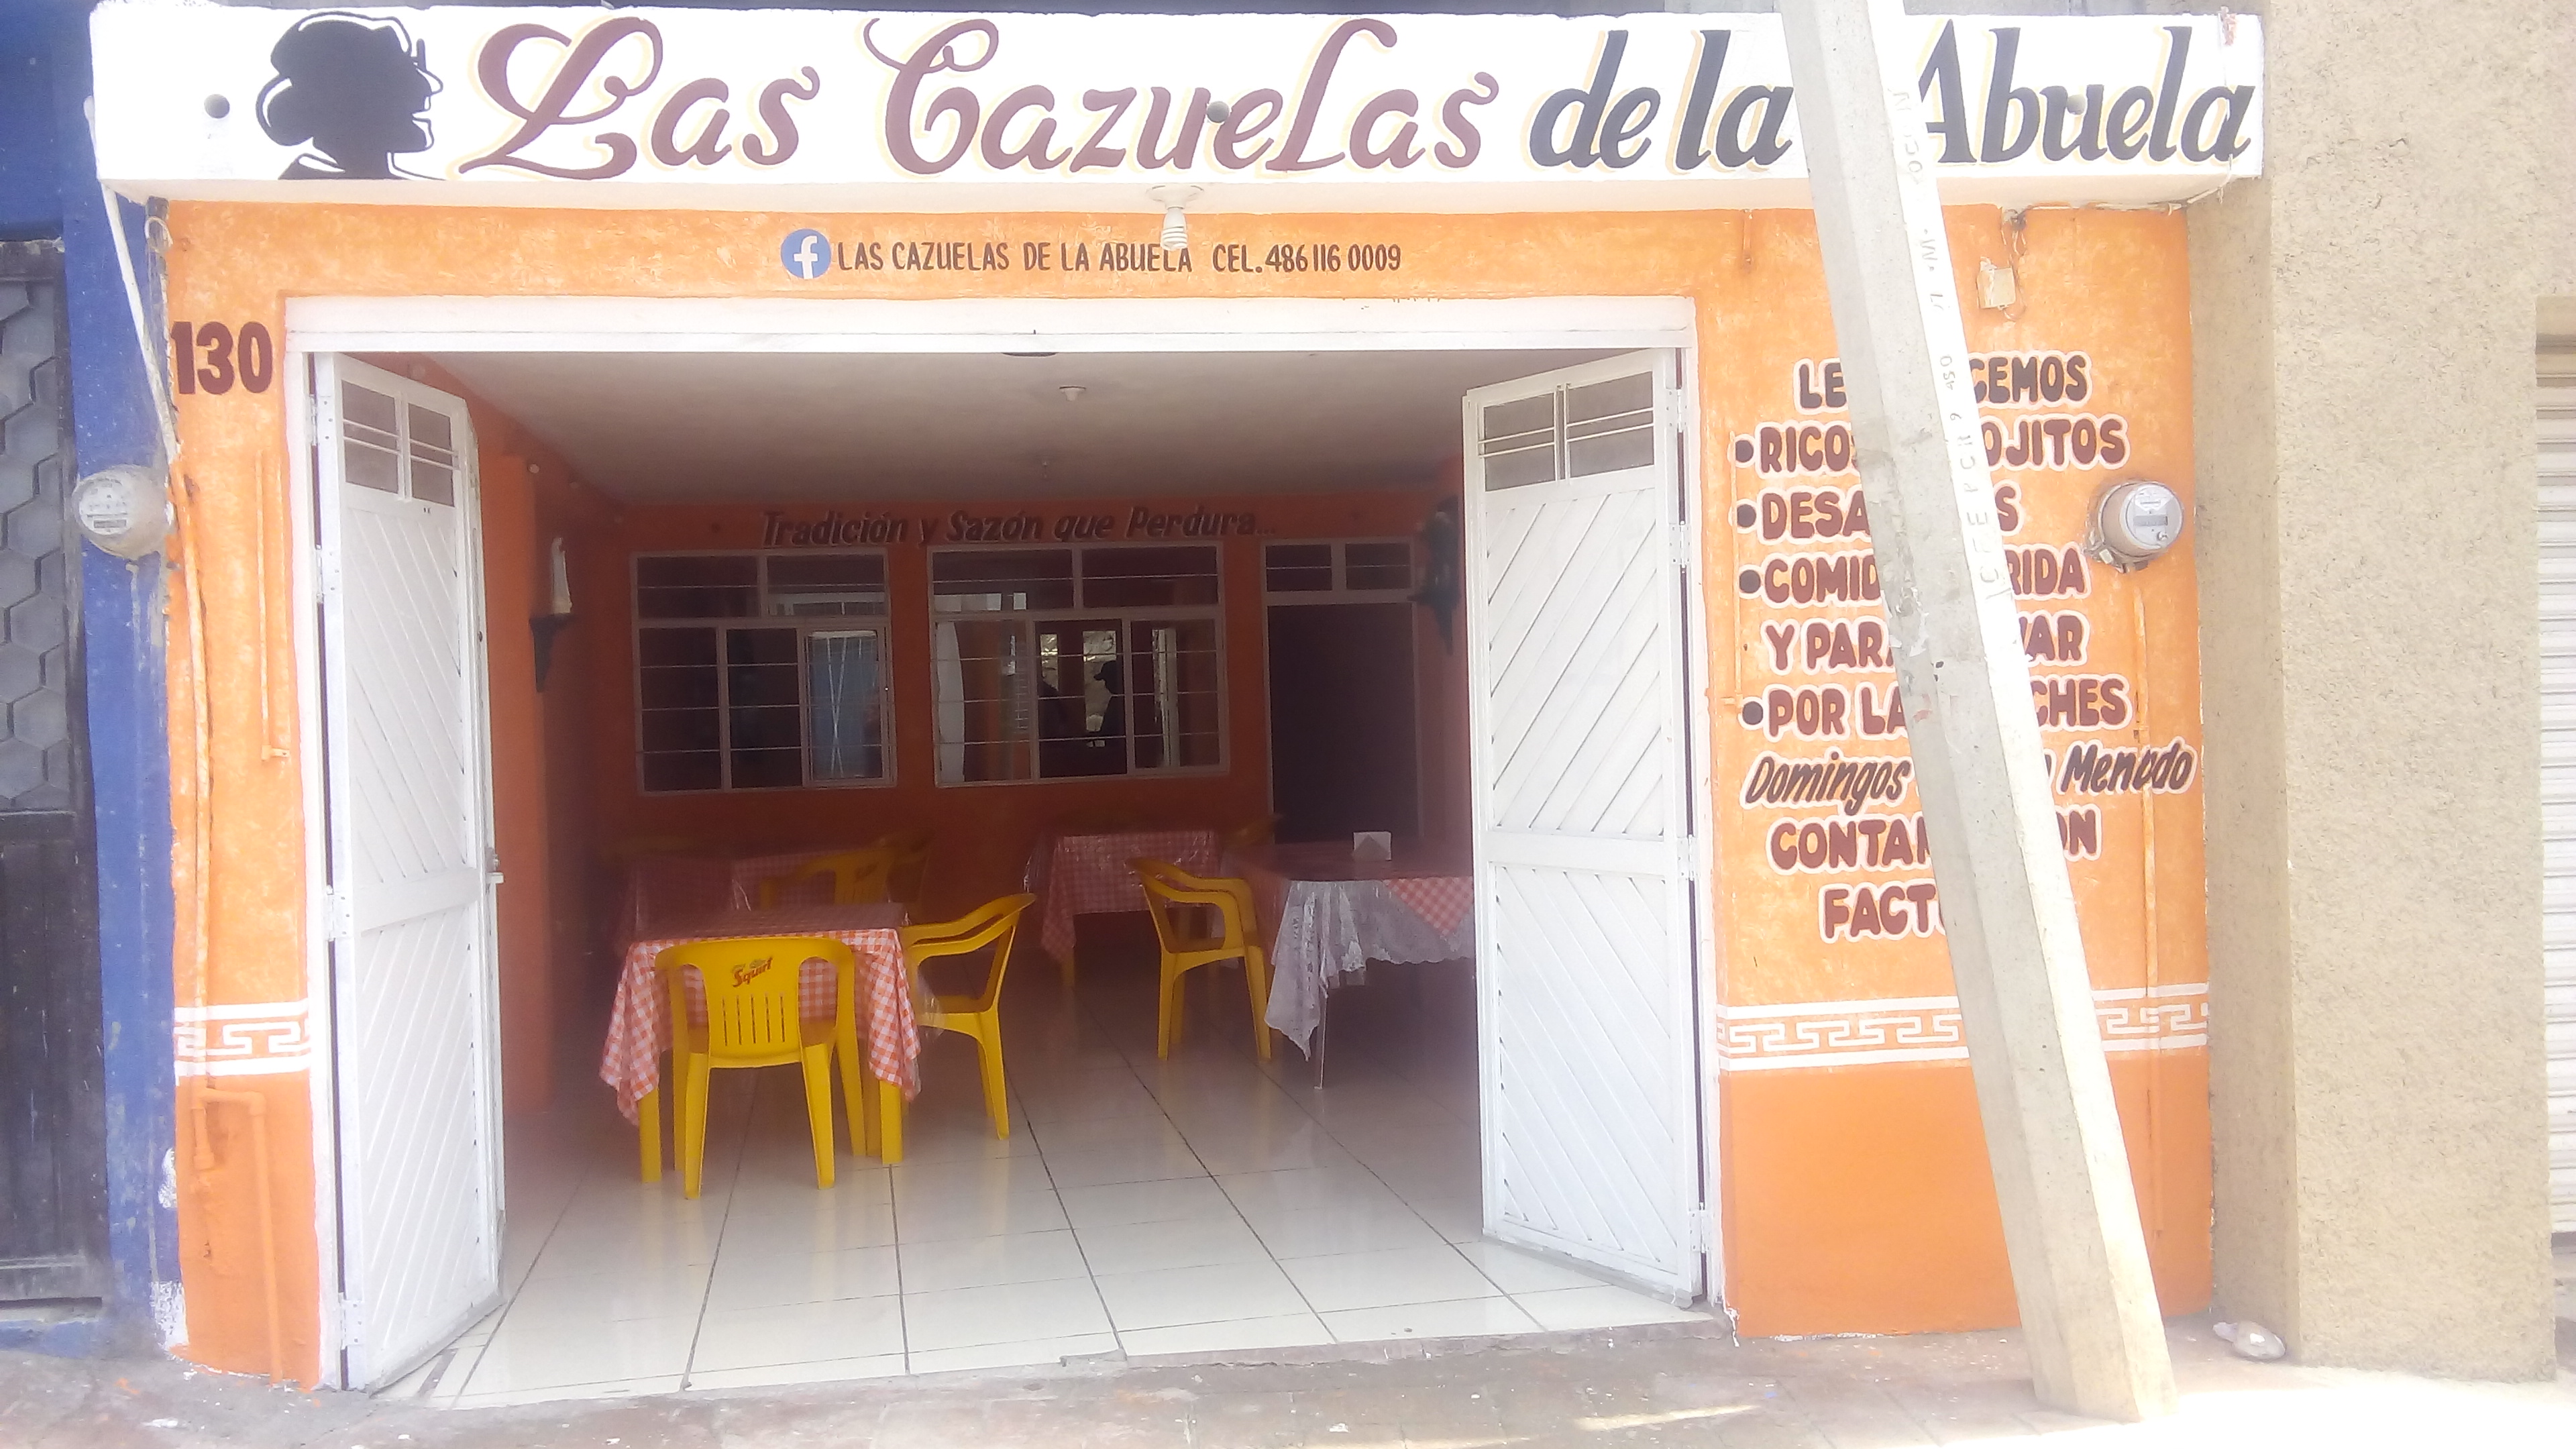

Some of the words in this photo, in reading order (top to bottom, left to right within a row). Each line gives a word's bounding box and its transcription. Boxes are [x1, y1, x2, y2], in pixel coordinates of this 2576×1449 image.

[459, 17, 819, 180] Las
[1529, 30, 1660, 168] de
[1675, 30, 1793, 168] la
[1918, 19, 2255, 163] Abuela
[837, 241, 883, 271] LAS
[892, 241, 1010, 271] CAZUELAS
[1023, 242, 1051, 271] DE
[1061, 242, 1089, 271] LA
[1099, 243, 1192, 272] ABUELA
[171, 321, 272, 394] 130
[1799, 363, 1847, 409] LE
[1970, 355, 2087, 403] CEMOS
[1760, 425, 1857, 472] RICO
[1981, 419, 2125, 466] OJITOS
[762, 510, 906, 547] Tradición
[919, 517, 940, 546] y
[947, 508, 1043, 541] Sazón
[1053, 514, 1114, 542] que
[1765, 555, 1880, 603] COMID
[1766, 625, 1795, 670] Y
[1807, 621, 1893, 669] PAR
[1769, 688, 1843, 737] POR
[1861, 687, 1906, 735] LA
[1746, 751, 1911, 816] Domingos
[1771, 816, 1930, 870] CONTA
[1824, 883, 1944, 938] FACT
